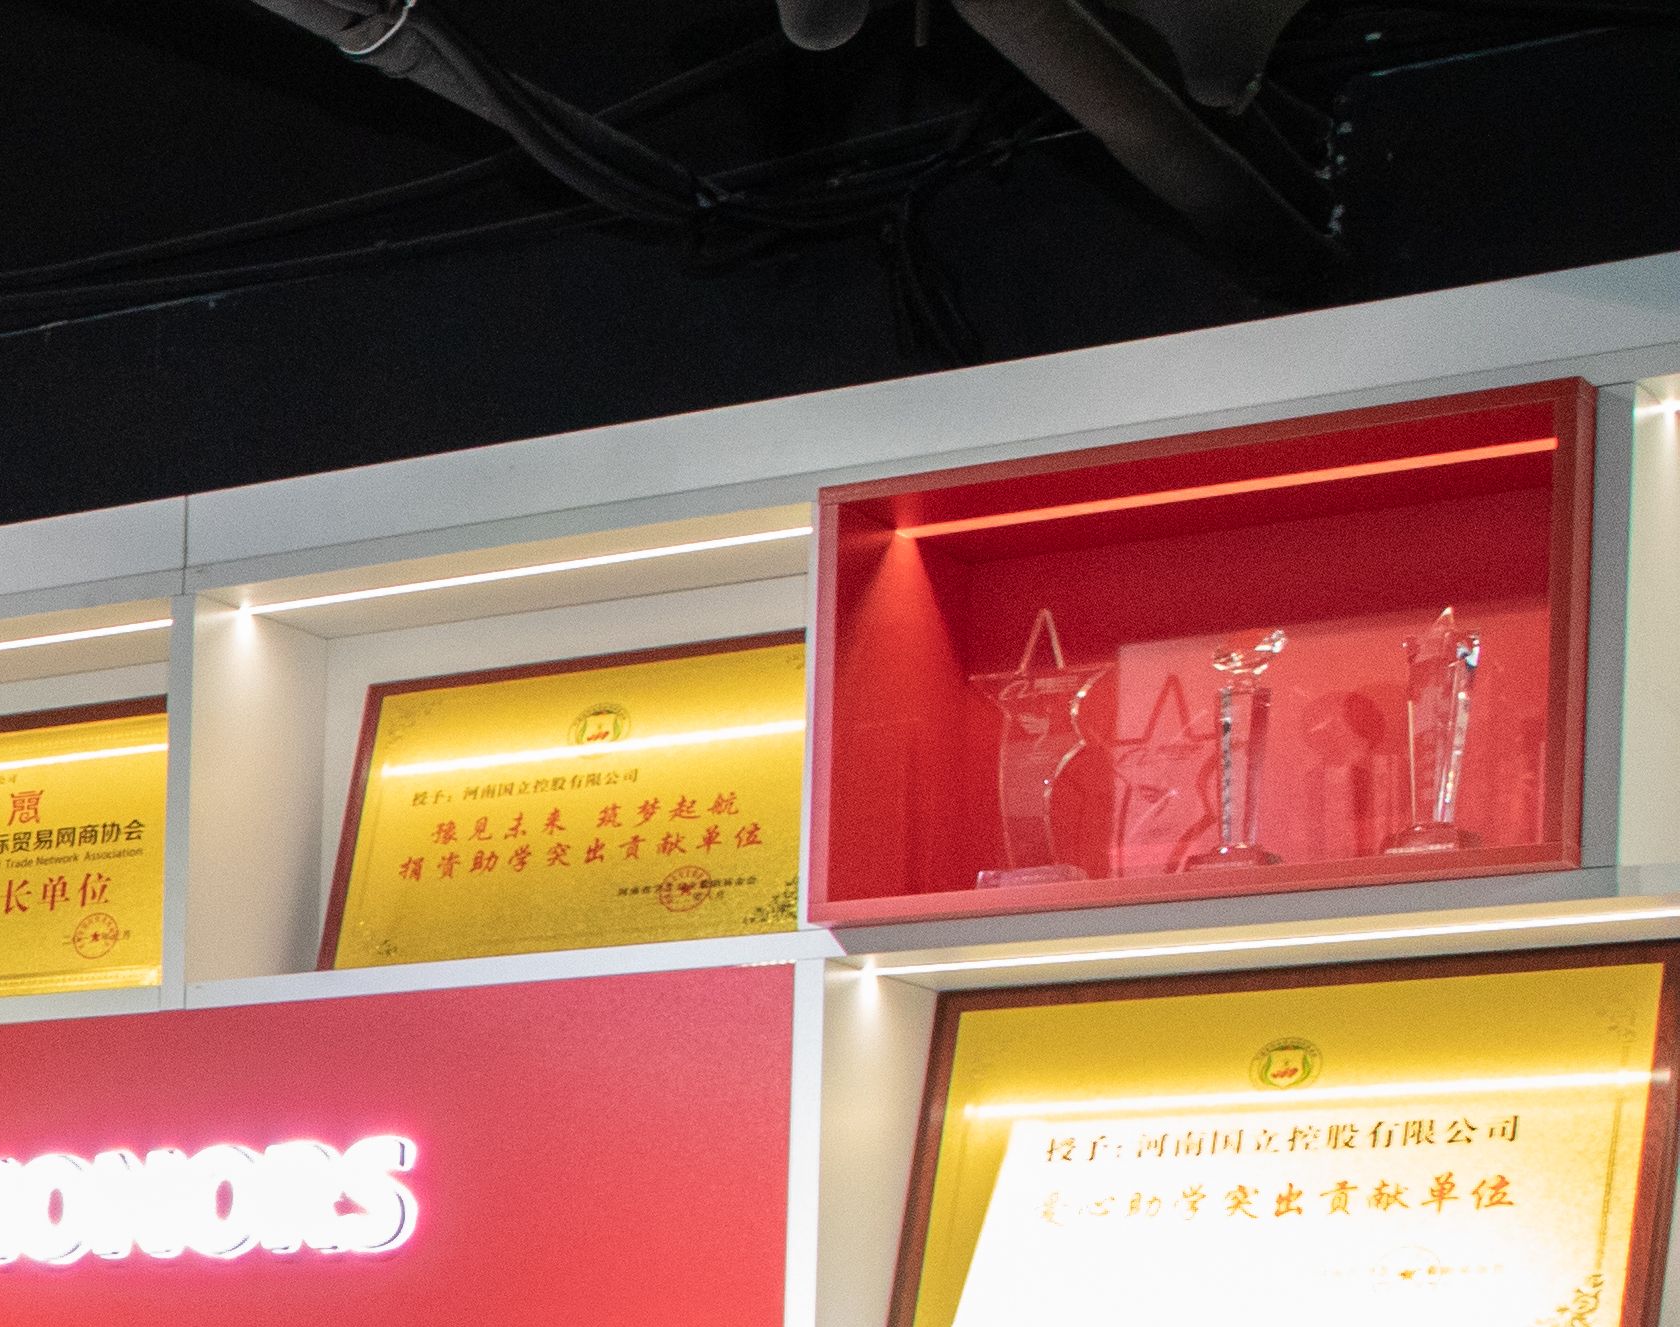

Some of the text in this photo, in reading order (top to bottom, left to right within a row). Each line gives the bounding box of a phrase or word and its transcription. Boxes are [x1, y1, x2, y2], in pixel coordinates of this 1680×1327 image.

[431, 791, 740, 845] 豫见未来 筑梦起航
[399, 822, 763, 881] 捐资助学突出贡献单位
